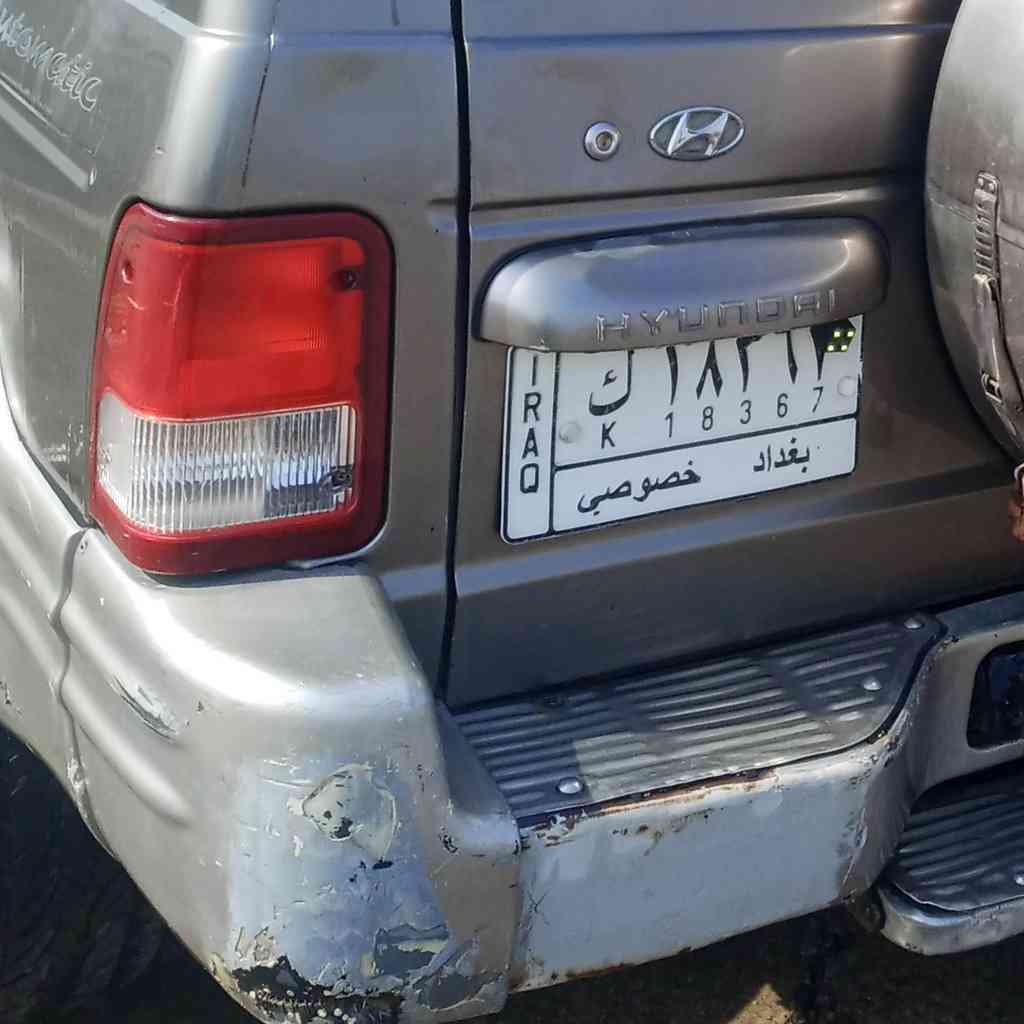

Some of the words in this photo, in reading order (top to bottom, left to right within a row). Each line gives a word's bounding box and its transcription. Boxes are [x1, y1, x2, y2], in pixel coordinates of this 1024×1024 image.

[594, 288, 836, 343] HYUNDAI
[600, 422, 616, 449] K
[753, 437, 811, 473] بغداد
[577, 460, 702, 516] خصوصي
